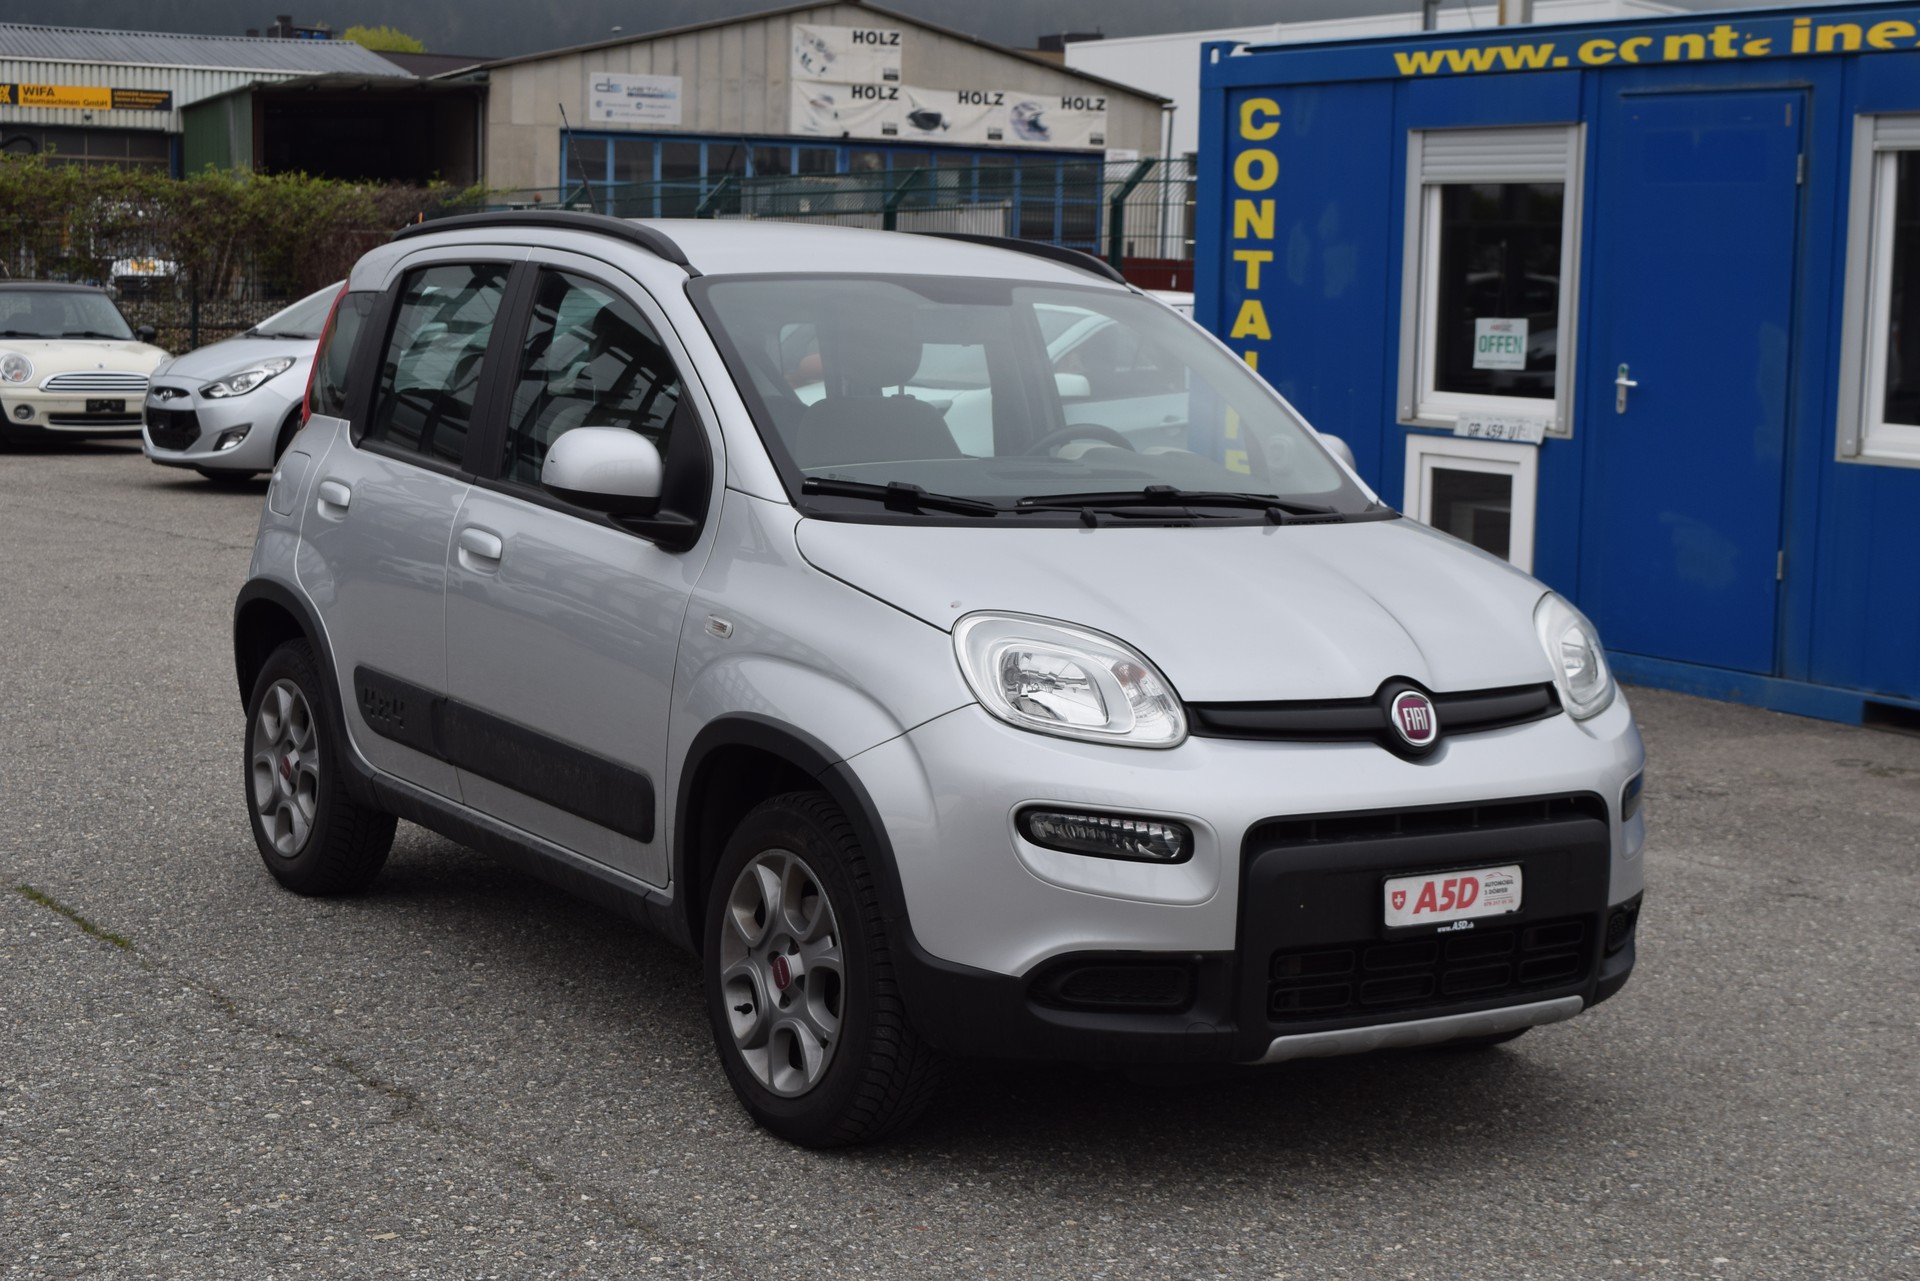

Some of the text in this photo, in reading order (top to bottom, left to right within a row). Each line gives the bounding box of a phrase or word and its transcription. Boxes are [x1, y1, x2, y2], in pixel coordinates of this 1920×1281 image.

[852, 31, 900, 47] HOLZ
[23, 86, 55, 98] WIFA
[851, 85, 899, 101] HOLZ
[957, 90, 1004, 106] HOLZ
[1061, 97, 1106, 112] HOLZ
[1478, 335, 1523, 353] OFFEN
[1402, 707, 1429, 731] FIAT
[1412, 877, 1480, 914] A5D
